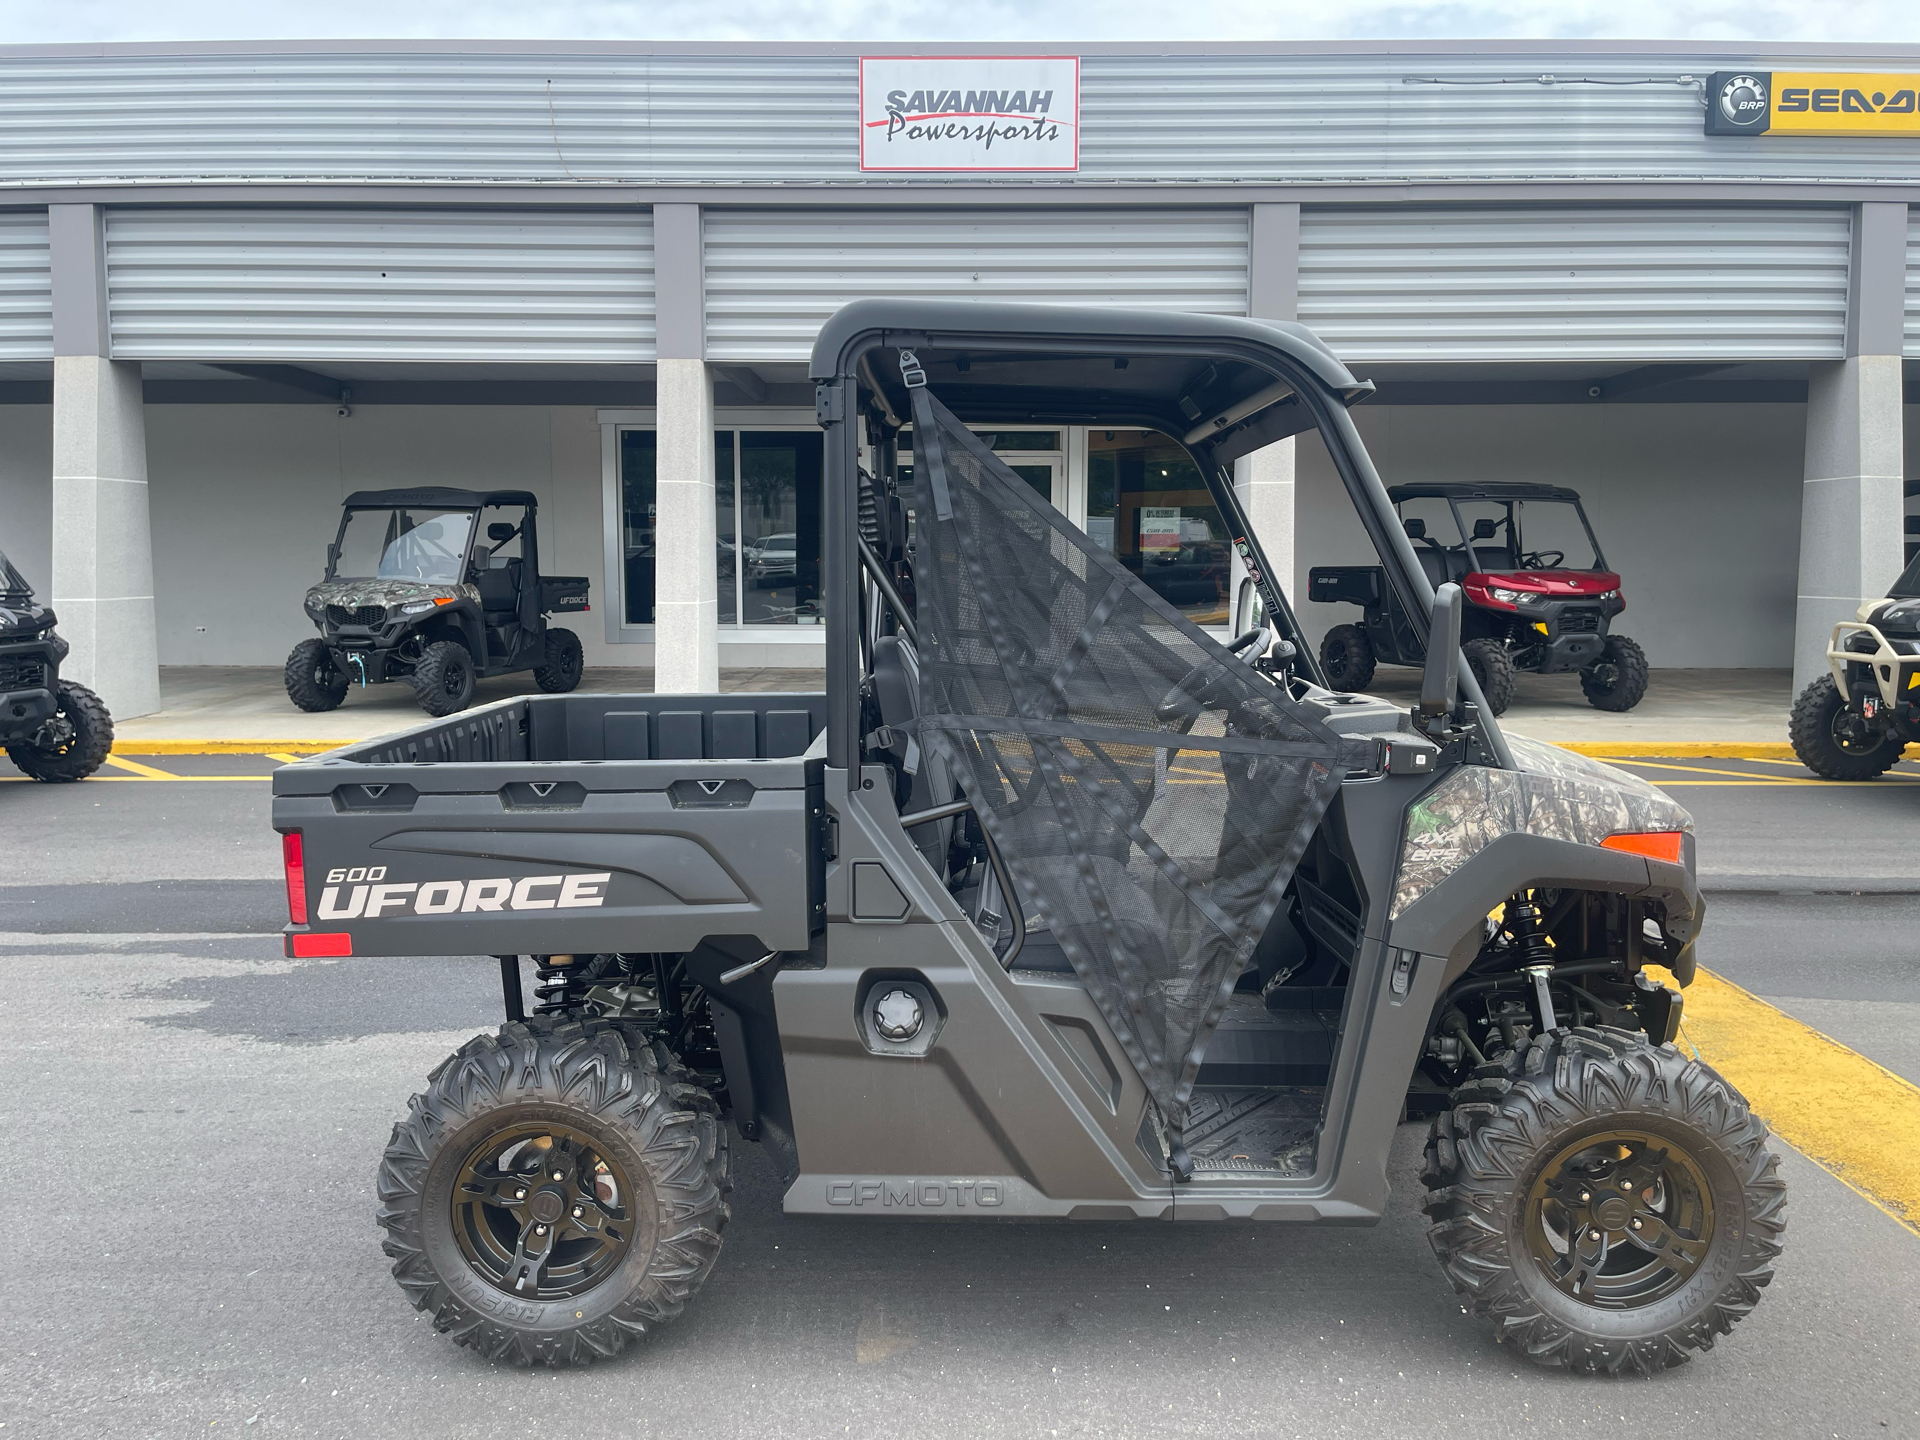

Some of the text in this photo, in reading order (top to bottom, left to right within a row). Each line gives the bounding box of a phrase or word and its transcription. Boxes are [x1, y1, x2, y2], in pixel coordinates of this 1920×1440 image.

[885, 90, 1053, 113] SAVANNAH
[1738, 101, 1764, 110] BRP
[887, 110, 1059, 150] Powersports
[560, 596, 588, 604] UFORCE
[1411, 848, 1460, 861] EPS
[326, 866, 387, 883] 600
[317, 873, 611, 920] UFORCE
[826, 1180, 1004, 1206] CFMOTO
[451, 1272, 545, 1324] ARISUN
